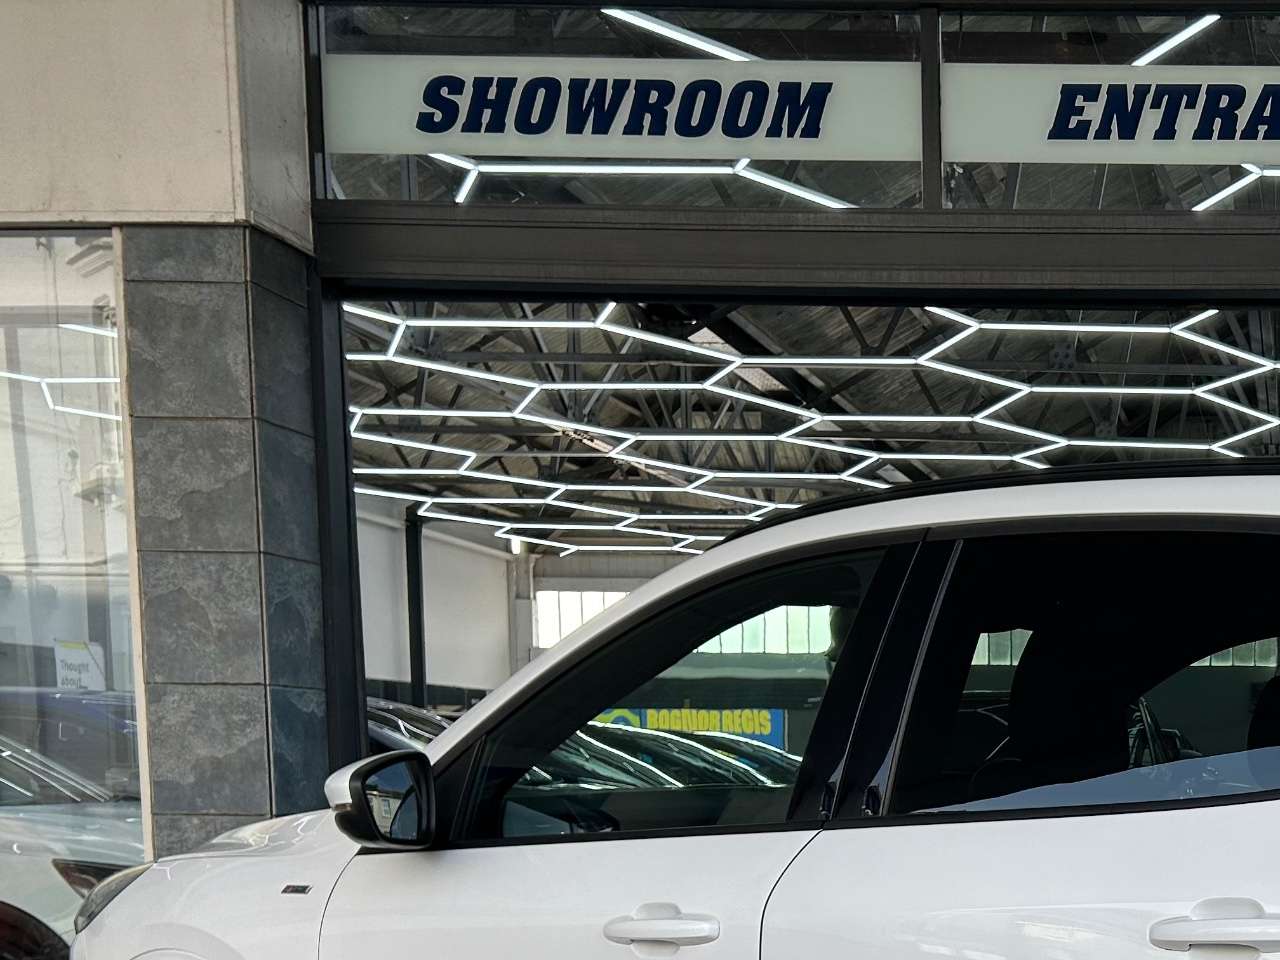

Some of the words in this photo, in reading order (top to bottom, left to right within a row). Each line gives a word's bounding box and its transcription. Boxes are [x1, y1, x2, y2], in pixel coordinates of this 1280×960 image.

[415, 74, 833, 139] SHOWROOM
[646, 708, 721, 733] BOGNOR
[722, 708, 772, 736] REGIS
